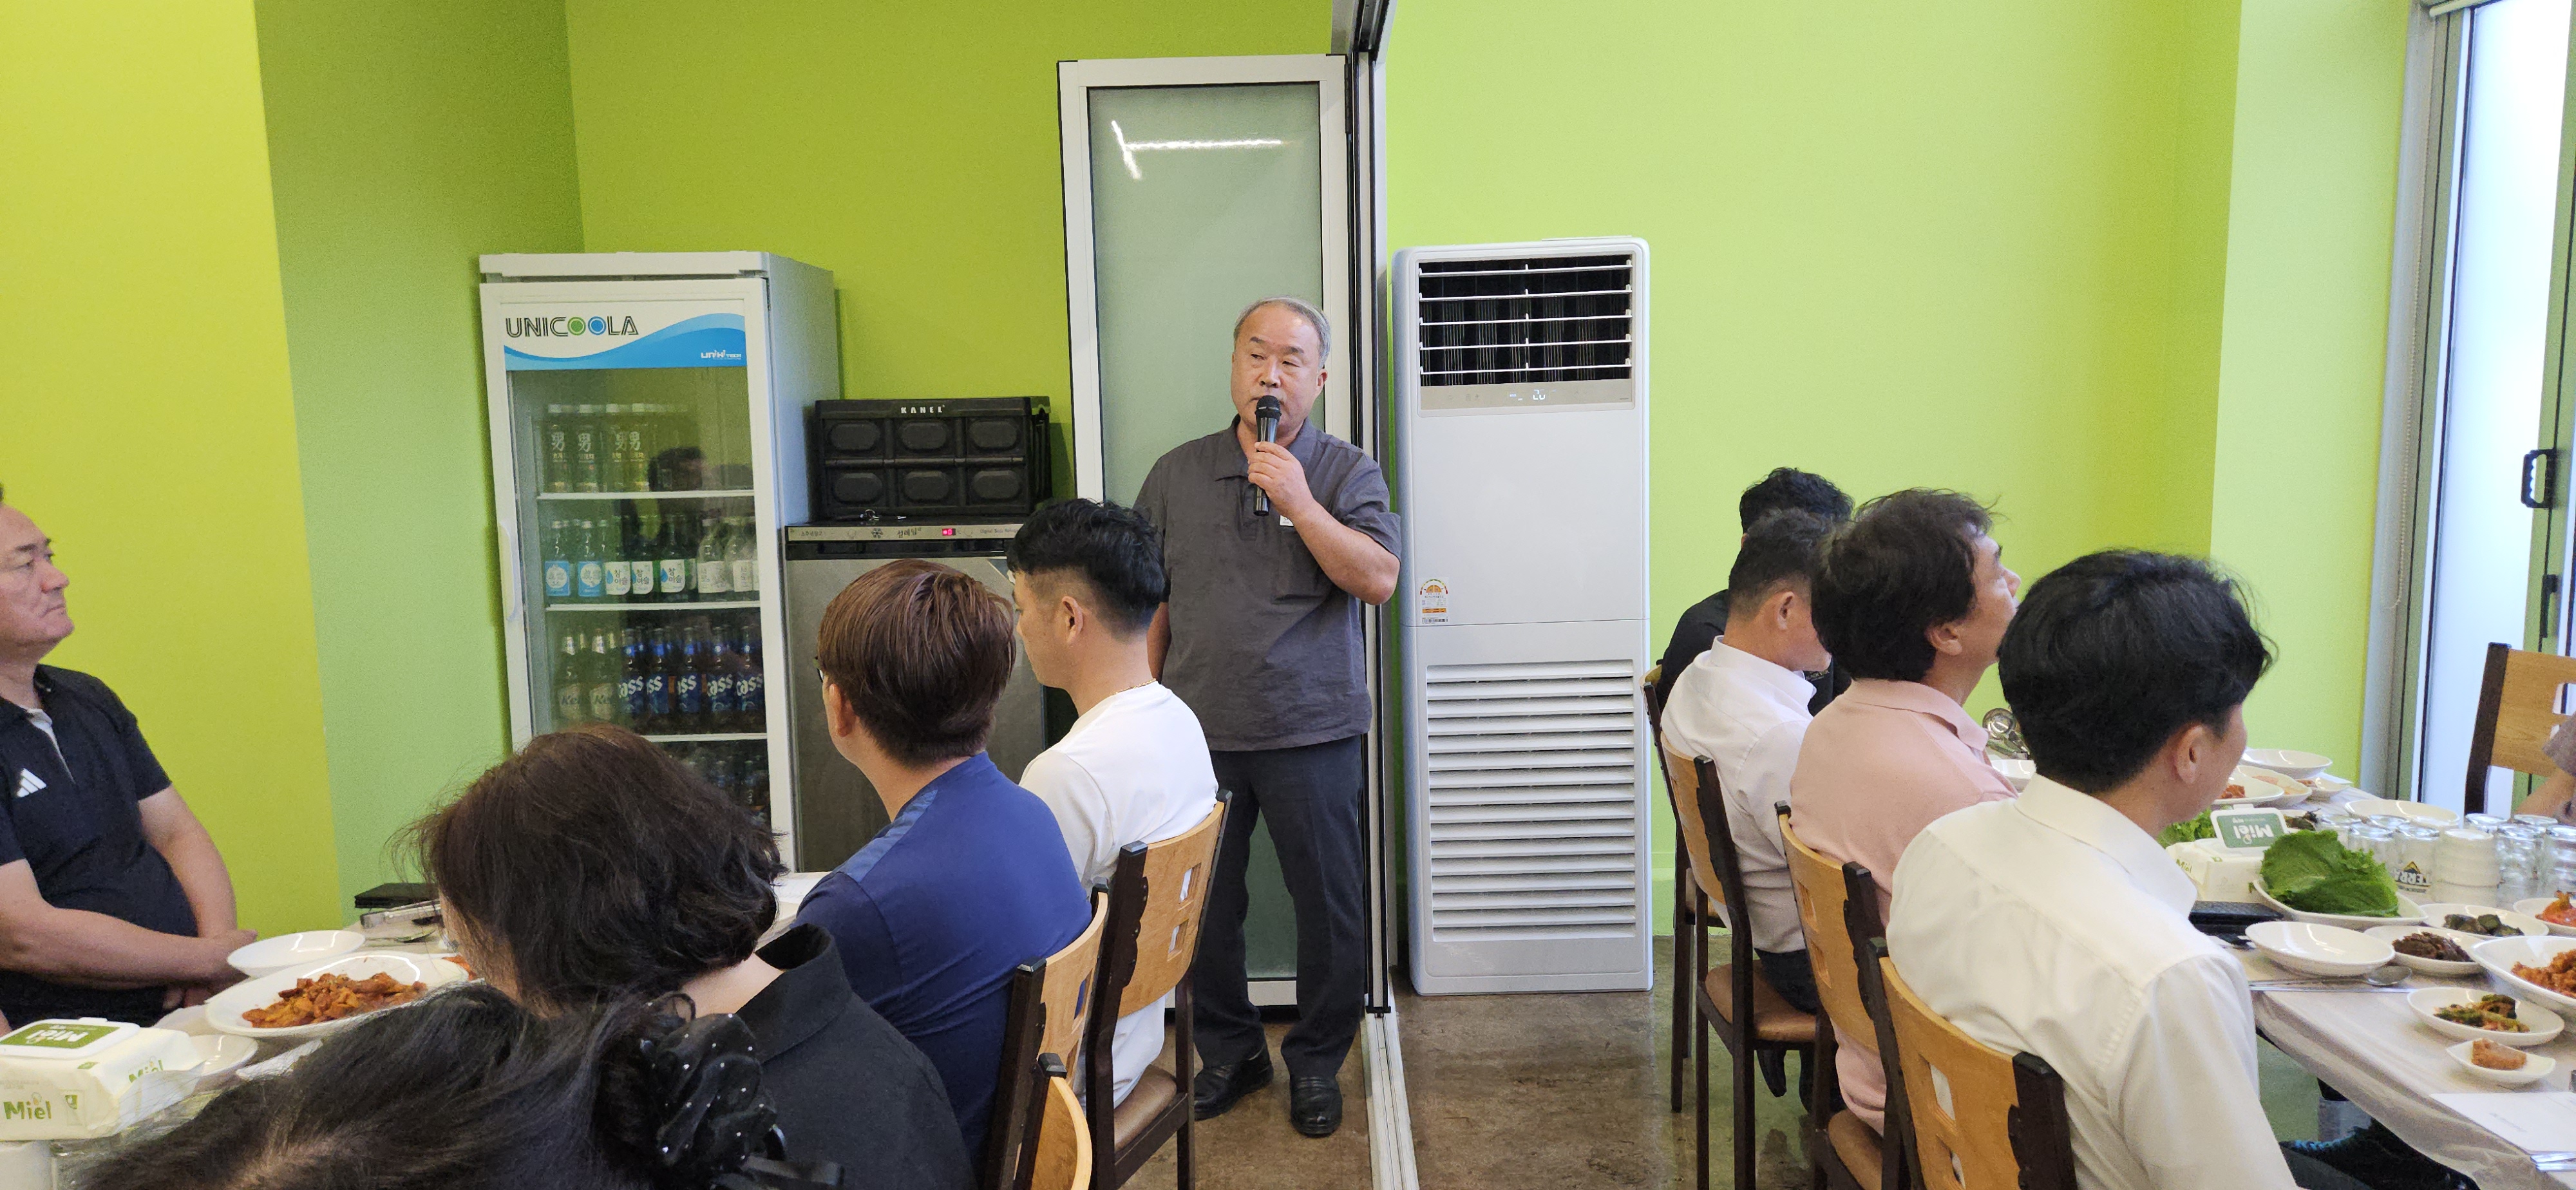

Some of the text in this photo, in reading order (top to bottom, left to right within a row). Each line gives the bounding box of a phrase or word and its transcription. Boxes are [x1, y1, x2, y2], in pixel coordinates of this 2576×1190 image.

[506, 316, 639, 337] UNICOOLA
[2233, 824, 2274, 839] Miel
[2393, 868, 2430, 885] TERRA
[25, 1029, 89, 1043] Miel
[3, 1100, 52, 1120] Miel
